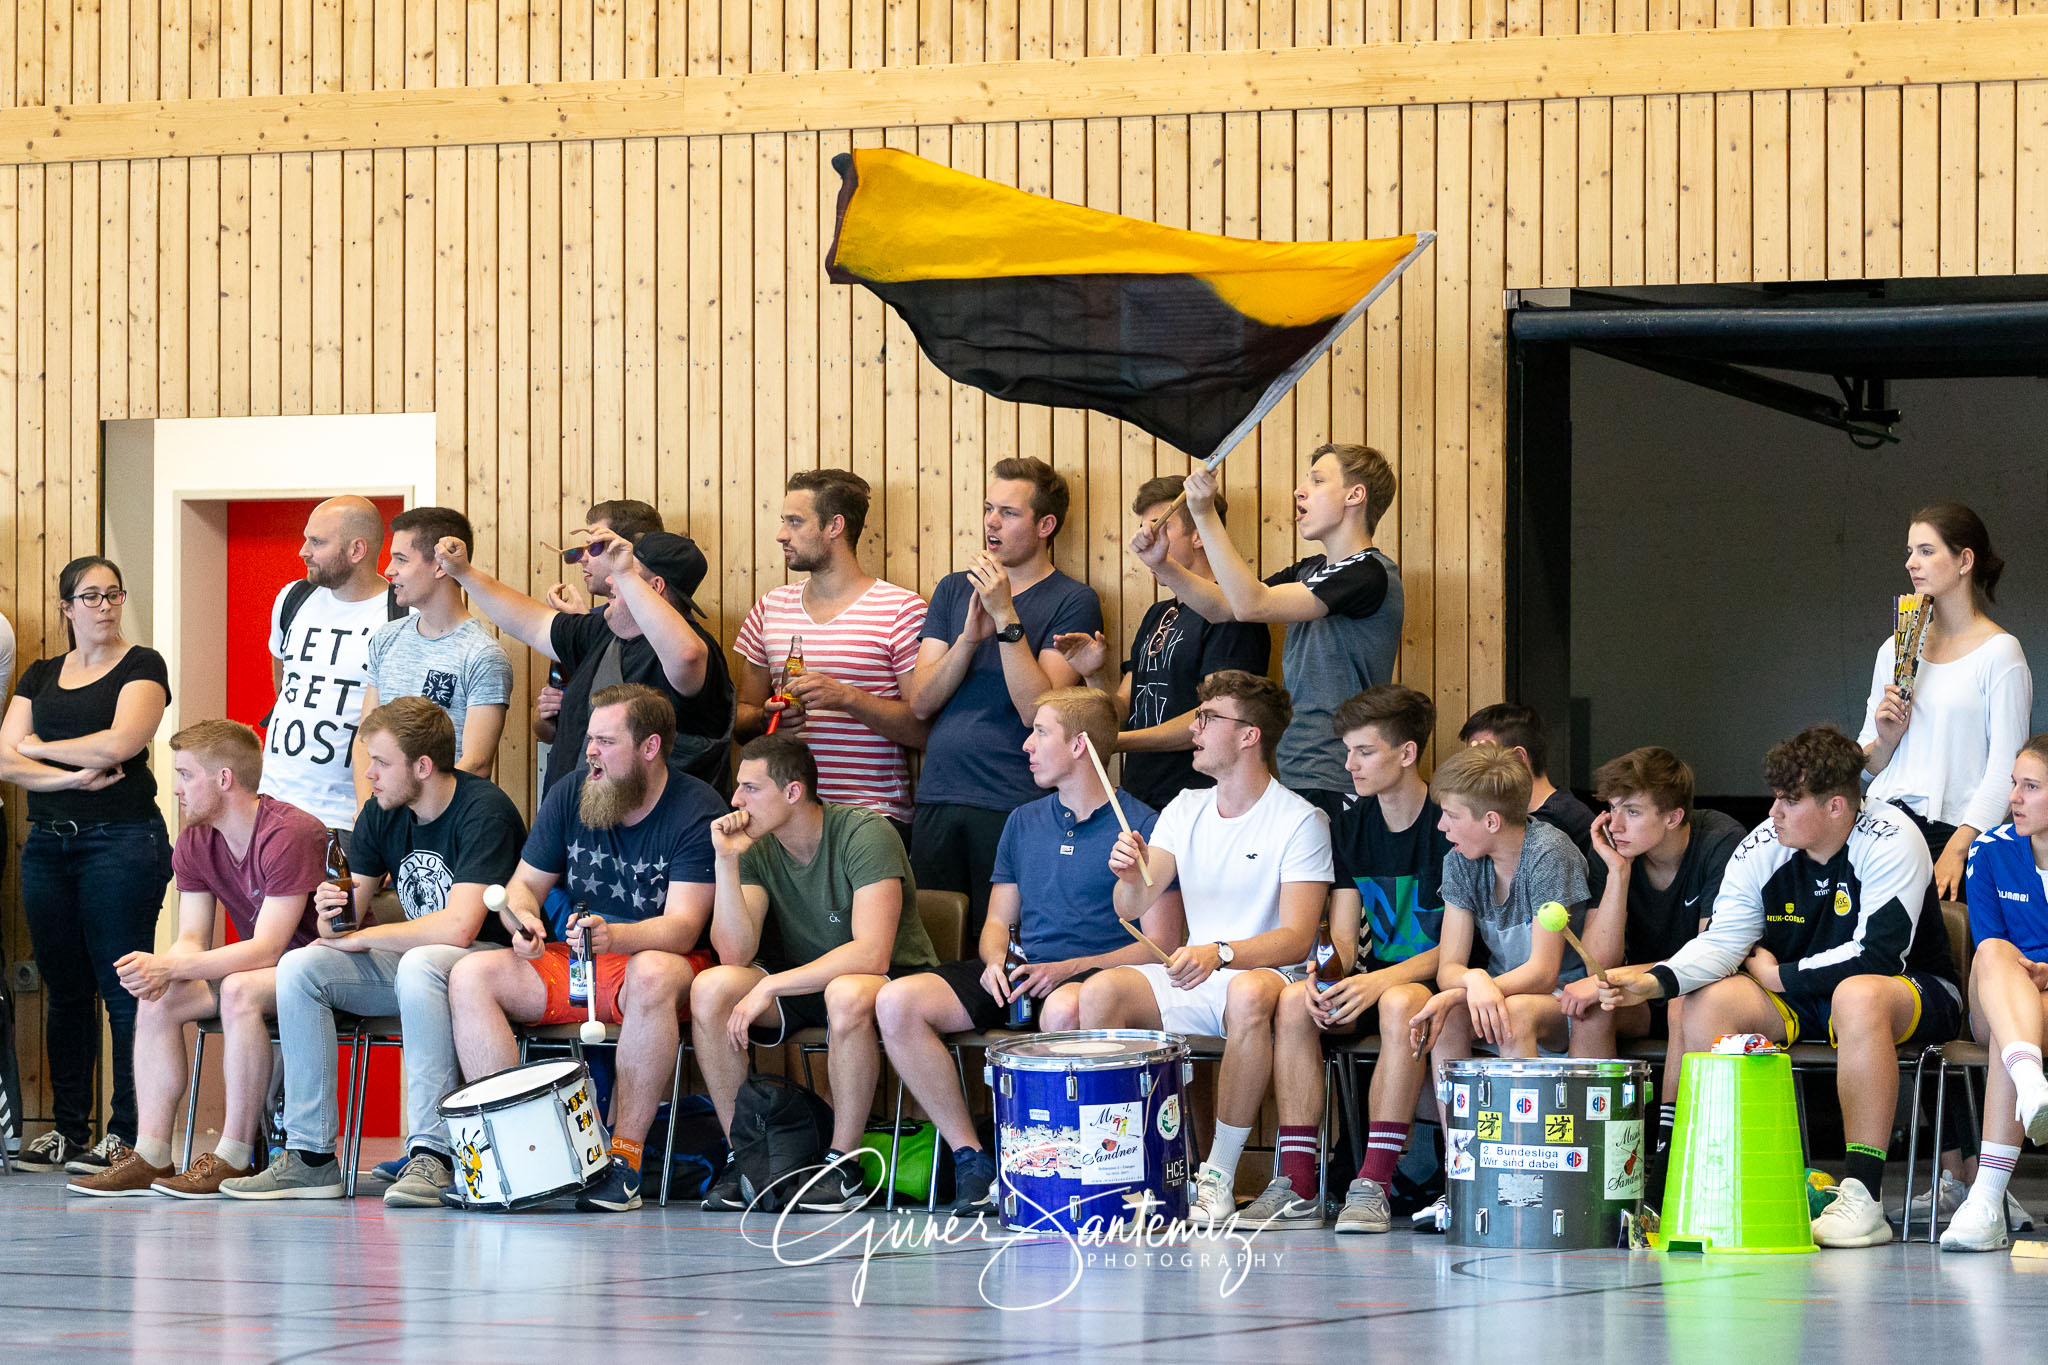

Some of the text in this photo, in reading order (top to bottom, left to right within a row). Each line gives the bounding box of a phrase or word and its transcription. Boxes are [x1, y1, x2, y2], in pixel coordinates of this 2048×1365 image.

[285, 672, 360, 716] GET
[271, 718, 358, 768] LOST
[1516, 1097, 1532, 1114] HG
[1592, 1096, 1606, 1112] HG
[1081, 1144, 1138, 1166] Sandner
[1497, 1146, 1559, 1159] Bundesliga
[1566, 1151, 1582, 1168] HG
[1166, 1159, 1185, 1180] HCE
[1482, 1156, 1559, 1169] Wir sind dabei
